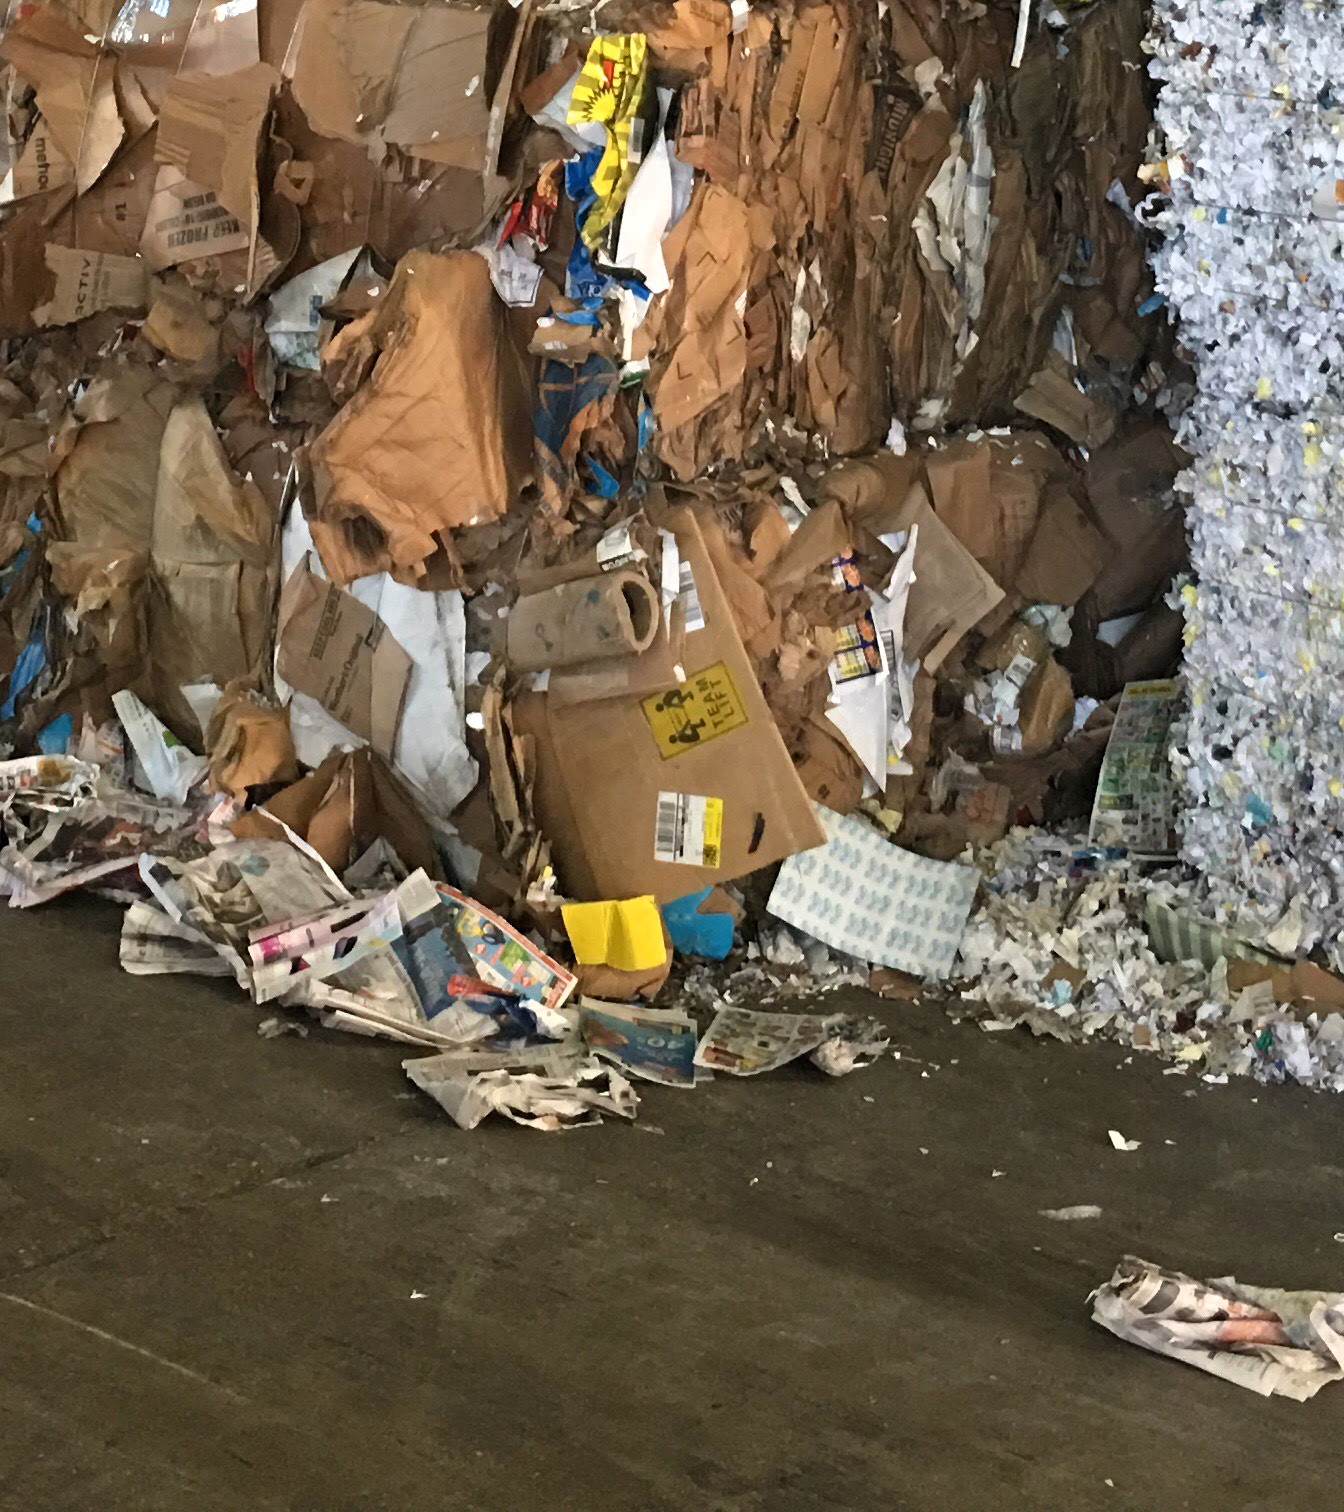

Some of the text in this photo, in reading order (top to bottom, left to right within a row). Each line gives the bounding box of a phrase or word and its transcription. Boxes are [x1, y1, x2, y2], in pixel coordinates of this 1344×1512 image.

[35, 137, 51, 190] meho
[168, 225, 208, 248] FROZEN
[696, 677, 724, 729] TEAM
[709, 680, 734, 718] LIFT
